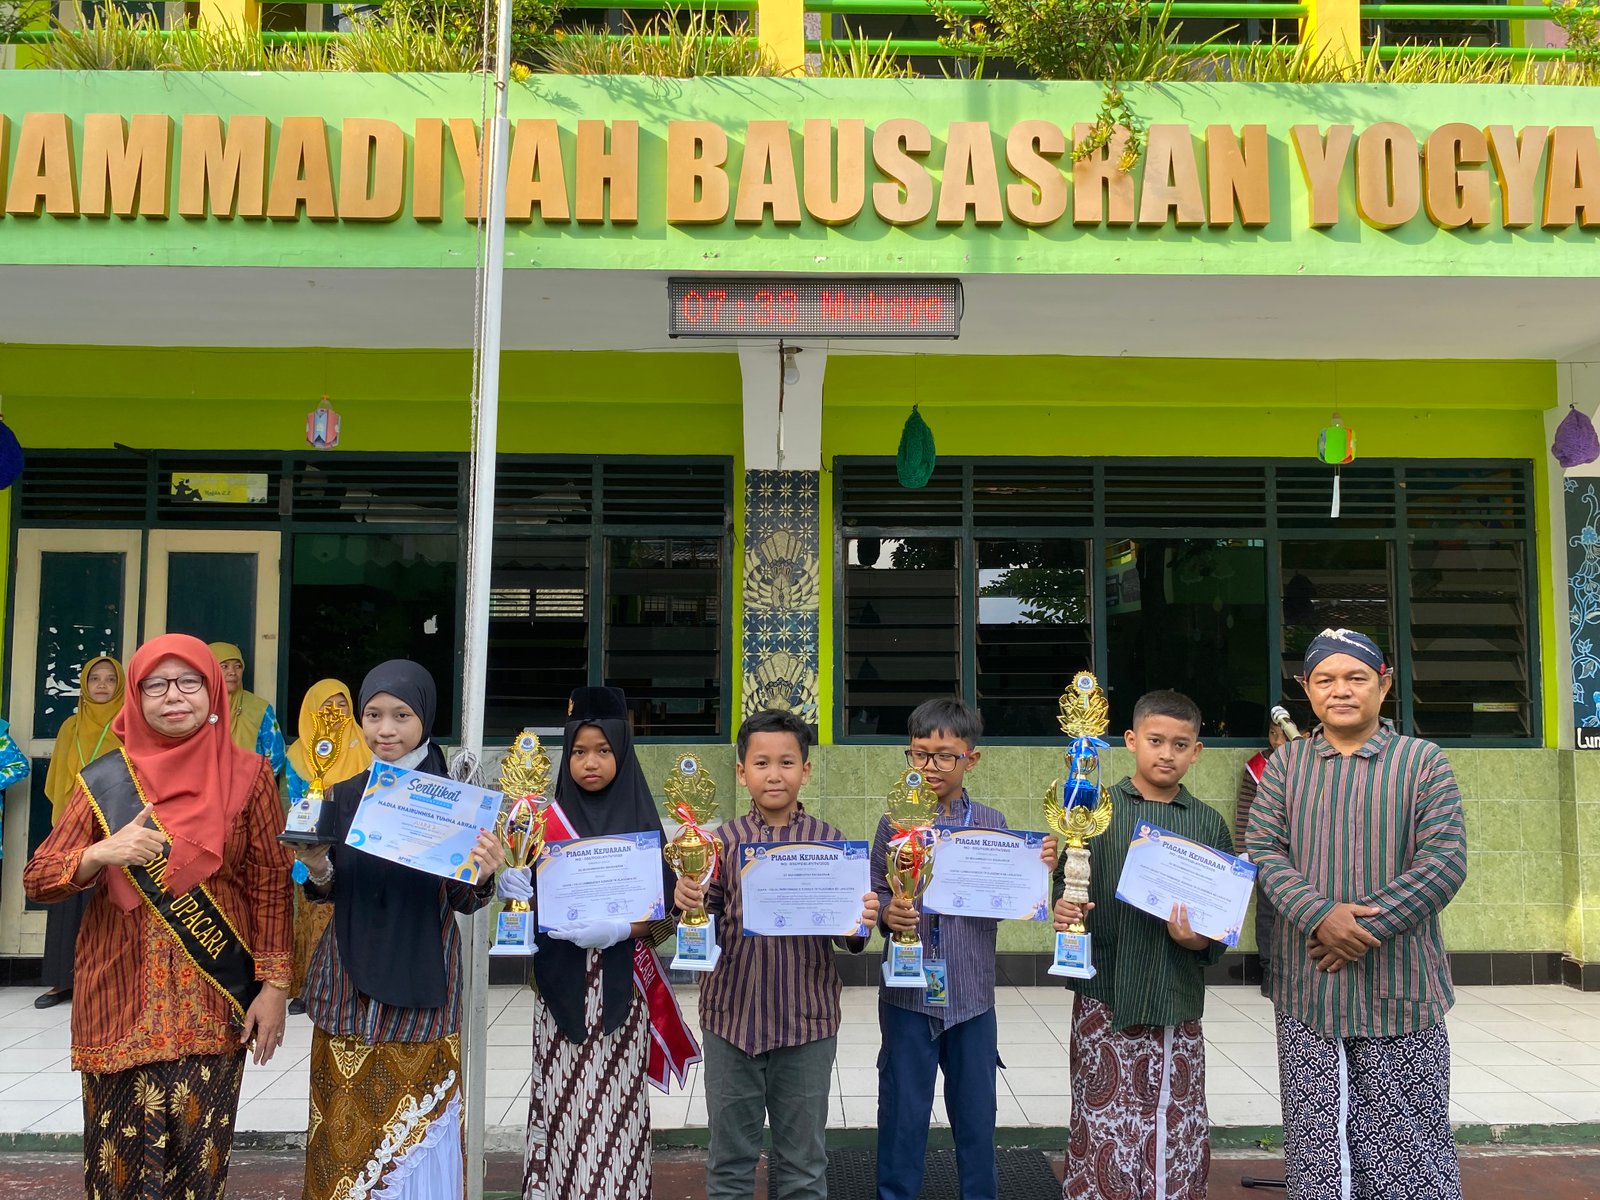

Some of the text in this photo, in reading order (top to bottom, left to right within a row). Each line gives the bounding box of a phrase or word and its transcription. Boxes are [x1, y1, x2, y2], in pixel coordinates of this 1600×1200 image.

[0, 112, 1600, 229] AMMADIYAH BAUSASRAN YOGYA
[682, 289, 799, 325] 07:33
[407, 778, 461, 802] Sertifikat
[566, 849, 591, 858] PIAGAM
[594, 845, 631, 855] KEJUARAAN
[955, 838, 1019, 848] PIAGAM KEJUARAAN
[1162, 841, 1226, 871] PIAGAM KEJUARAAN
[799, 853, 838, 861] KEJUARAAN
[169, 893, 228, 960] UPACARA
